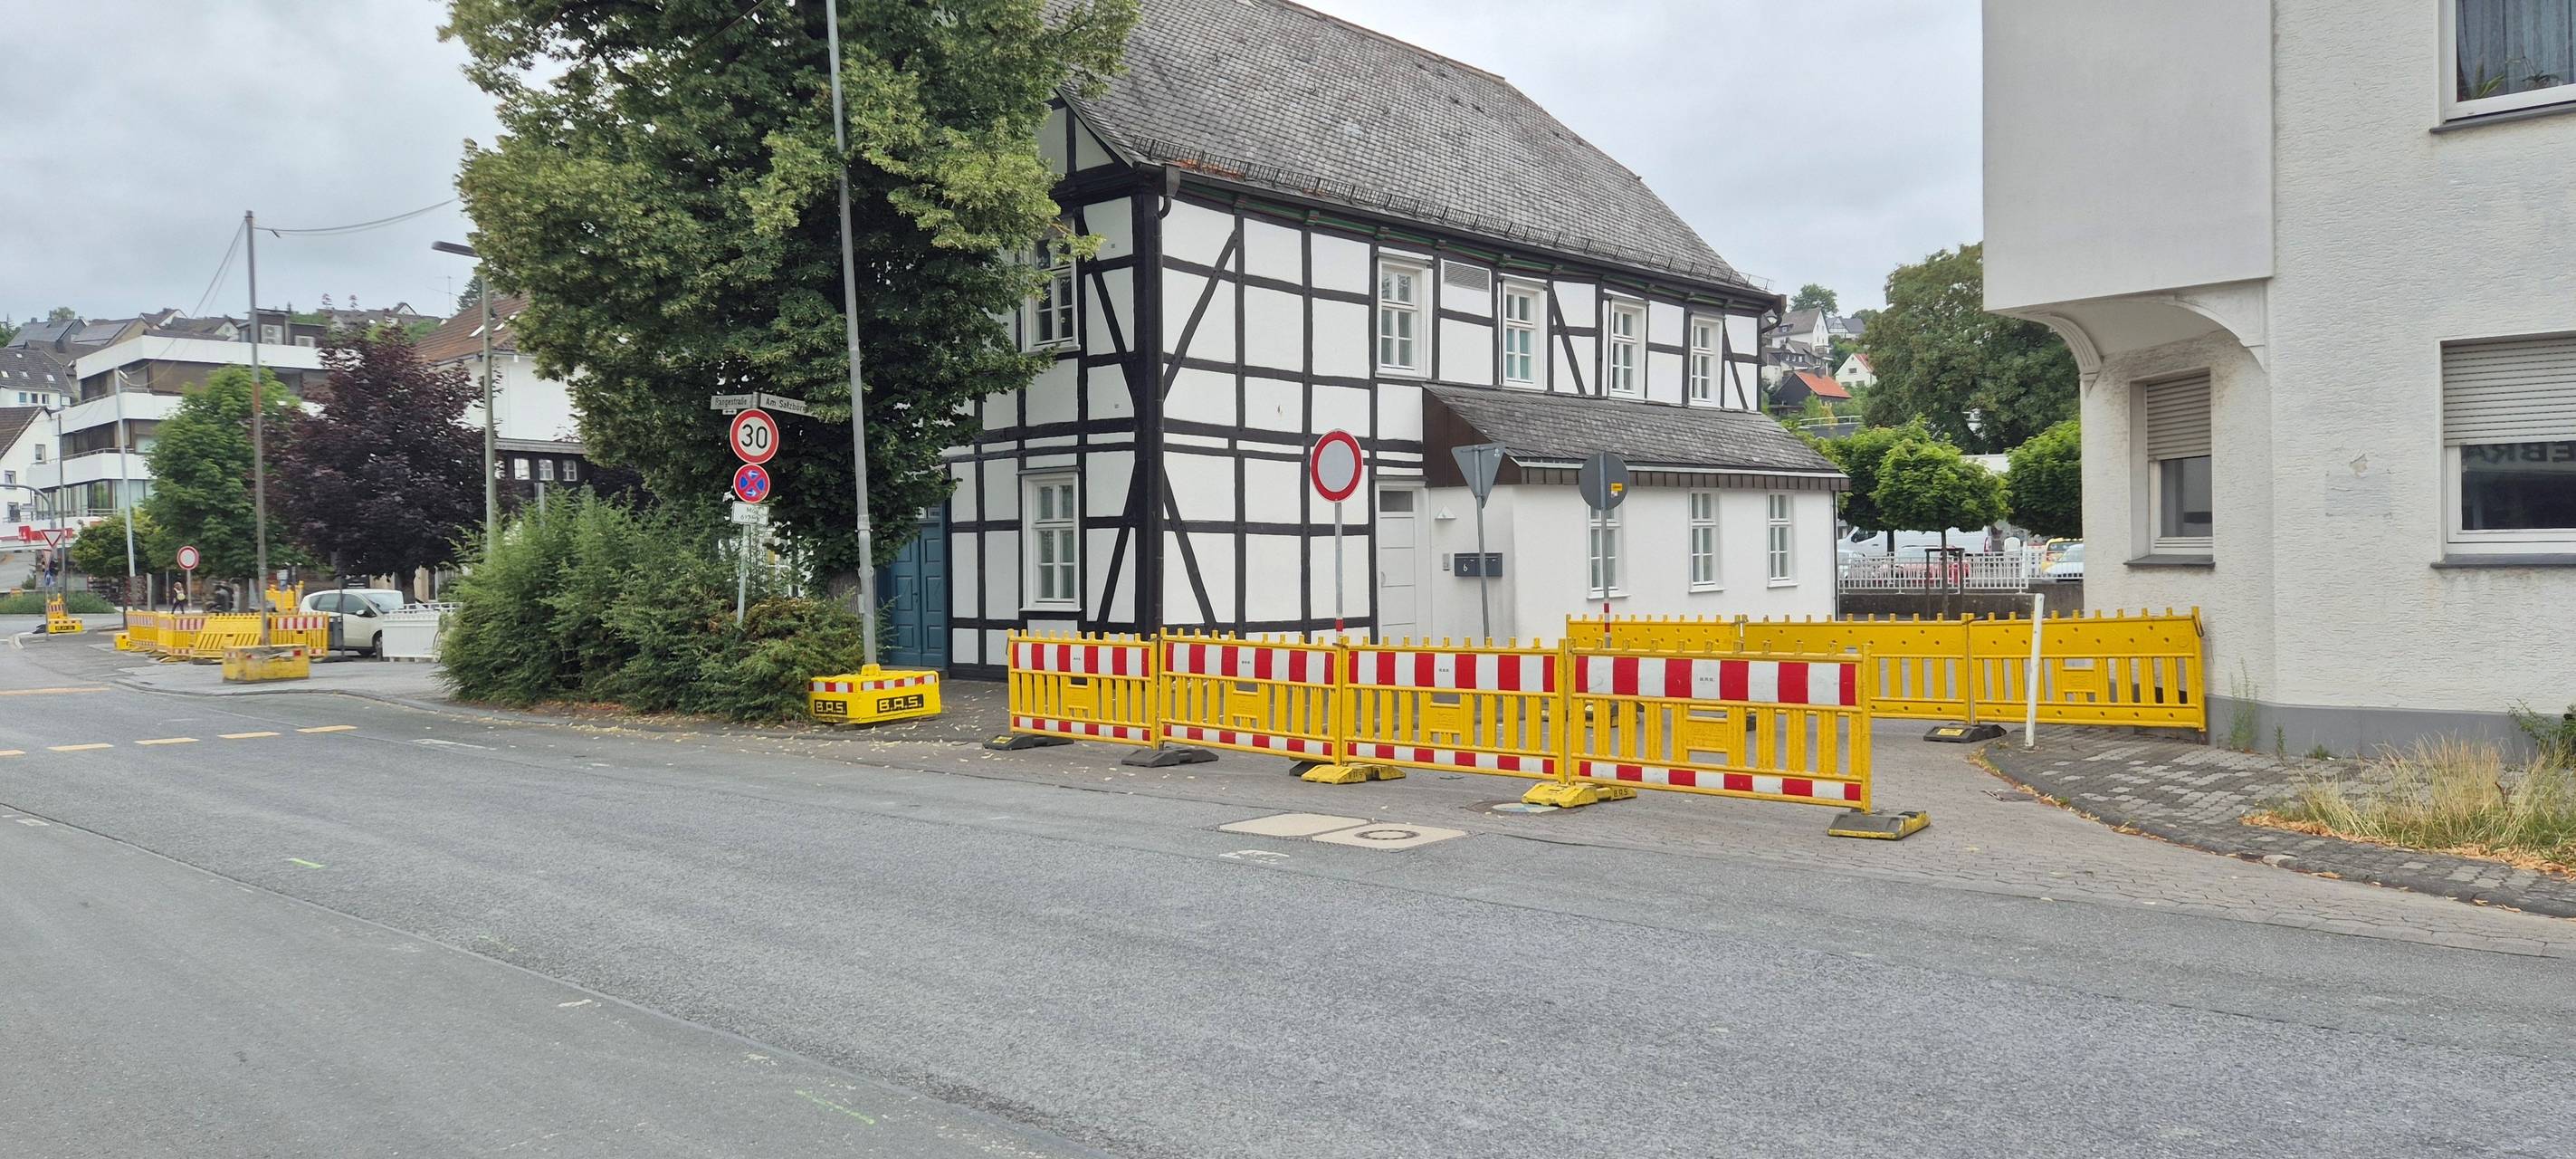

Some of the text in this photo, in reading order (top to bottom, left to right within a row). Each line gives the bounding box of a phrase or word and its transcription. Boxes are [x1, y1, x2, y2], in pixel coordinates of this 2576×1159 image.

[766, 398, 777, 407] Am
[741, 424, 768, 449] 30
[1463, 563, 1468, 572] 6
[816, 701, 846, 714] B.A.S.
[879, 696, 922, 712] B.A.S.
